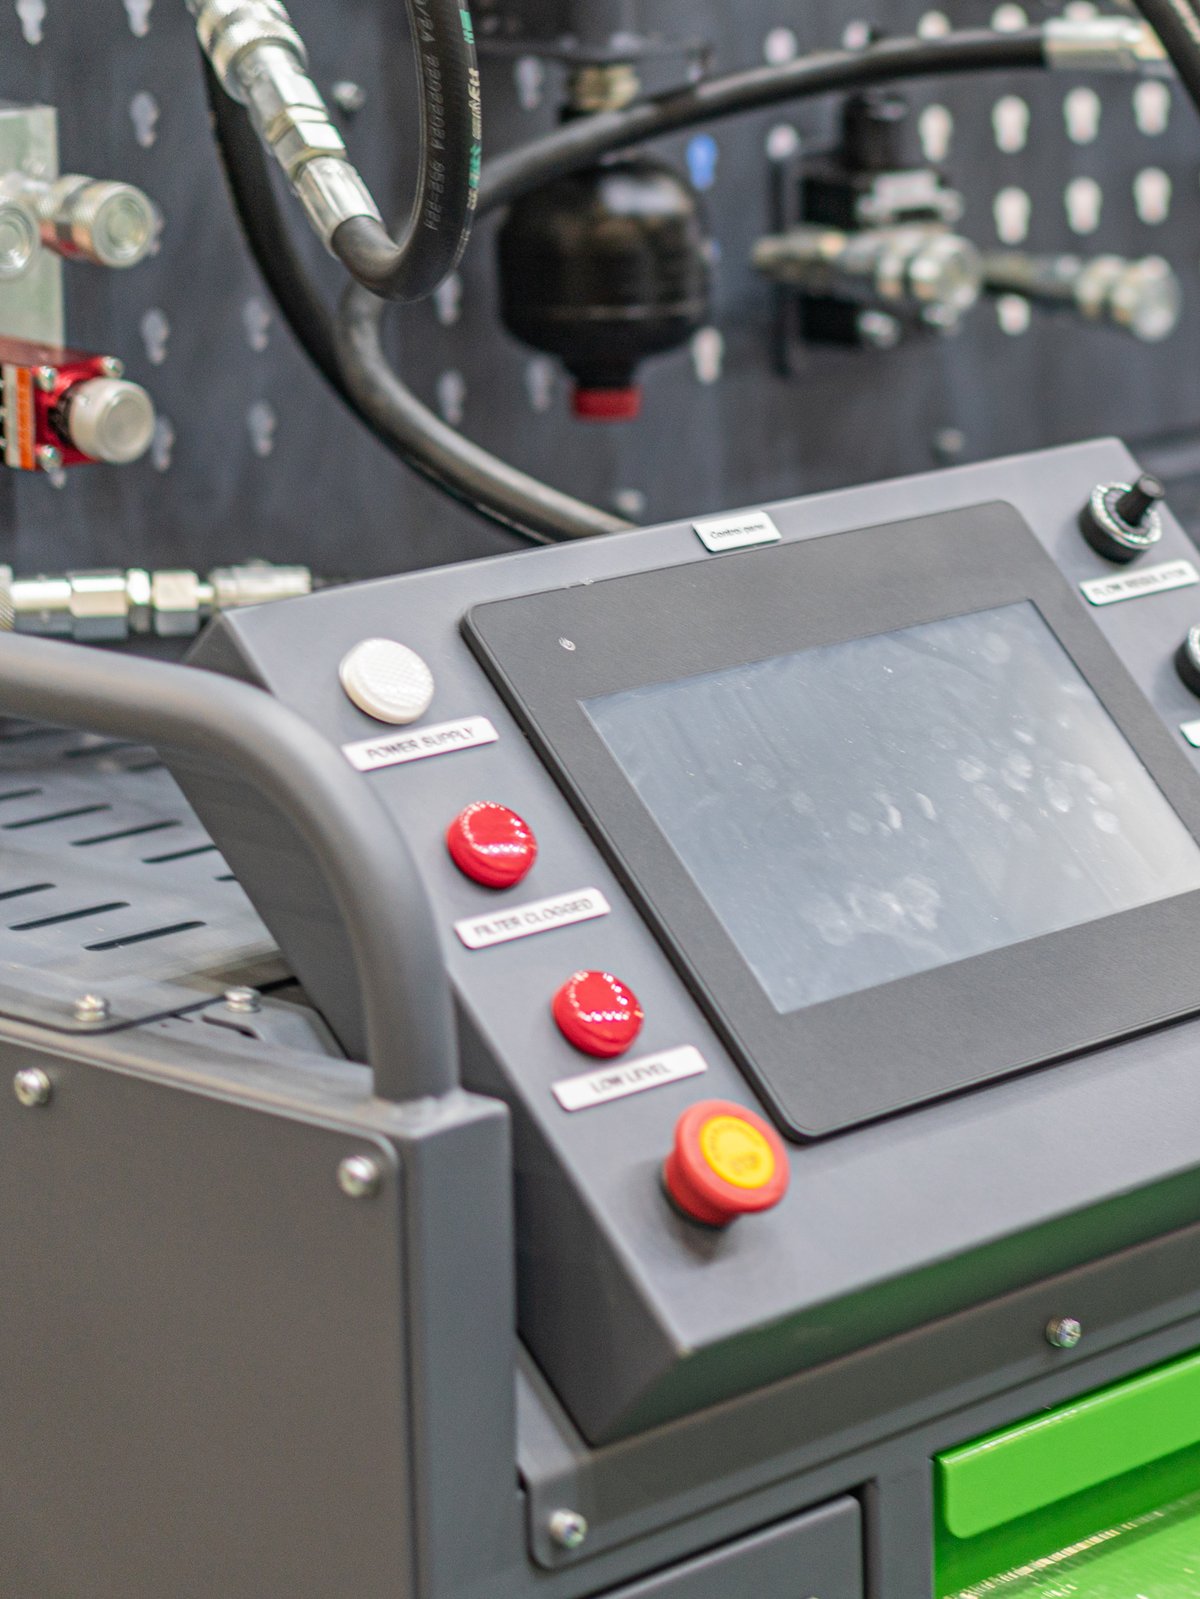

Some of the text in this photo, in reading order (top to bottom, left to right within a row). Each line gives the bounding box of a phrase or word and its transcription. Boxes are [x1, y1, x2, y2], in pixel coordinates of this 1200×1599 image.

[366, 727, 474, 761] POWER SUPPLY
[473, 898, 593, 937] FILTER CLOGGED
[590, 1062, 671, 1093] LOW LEVEL
